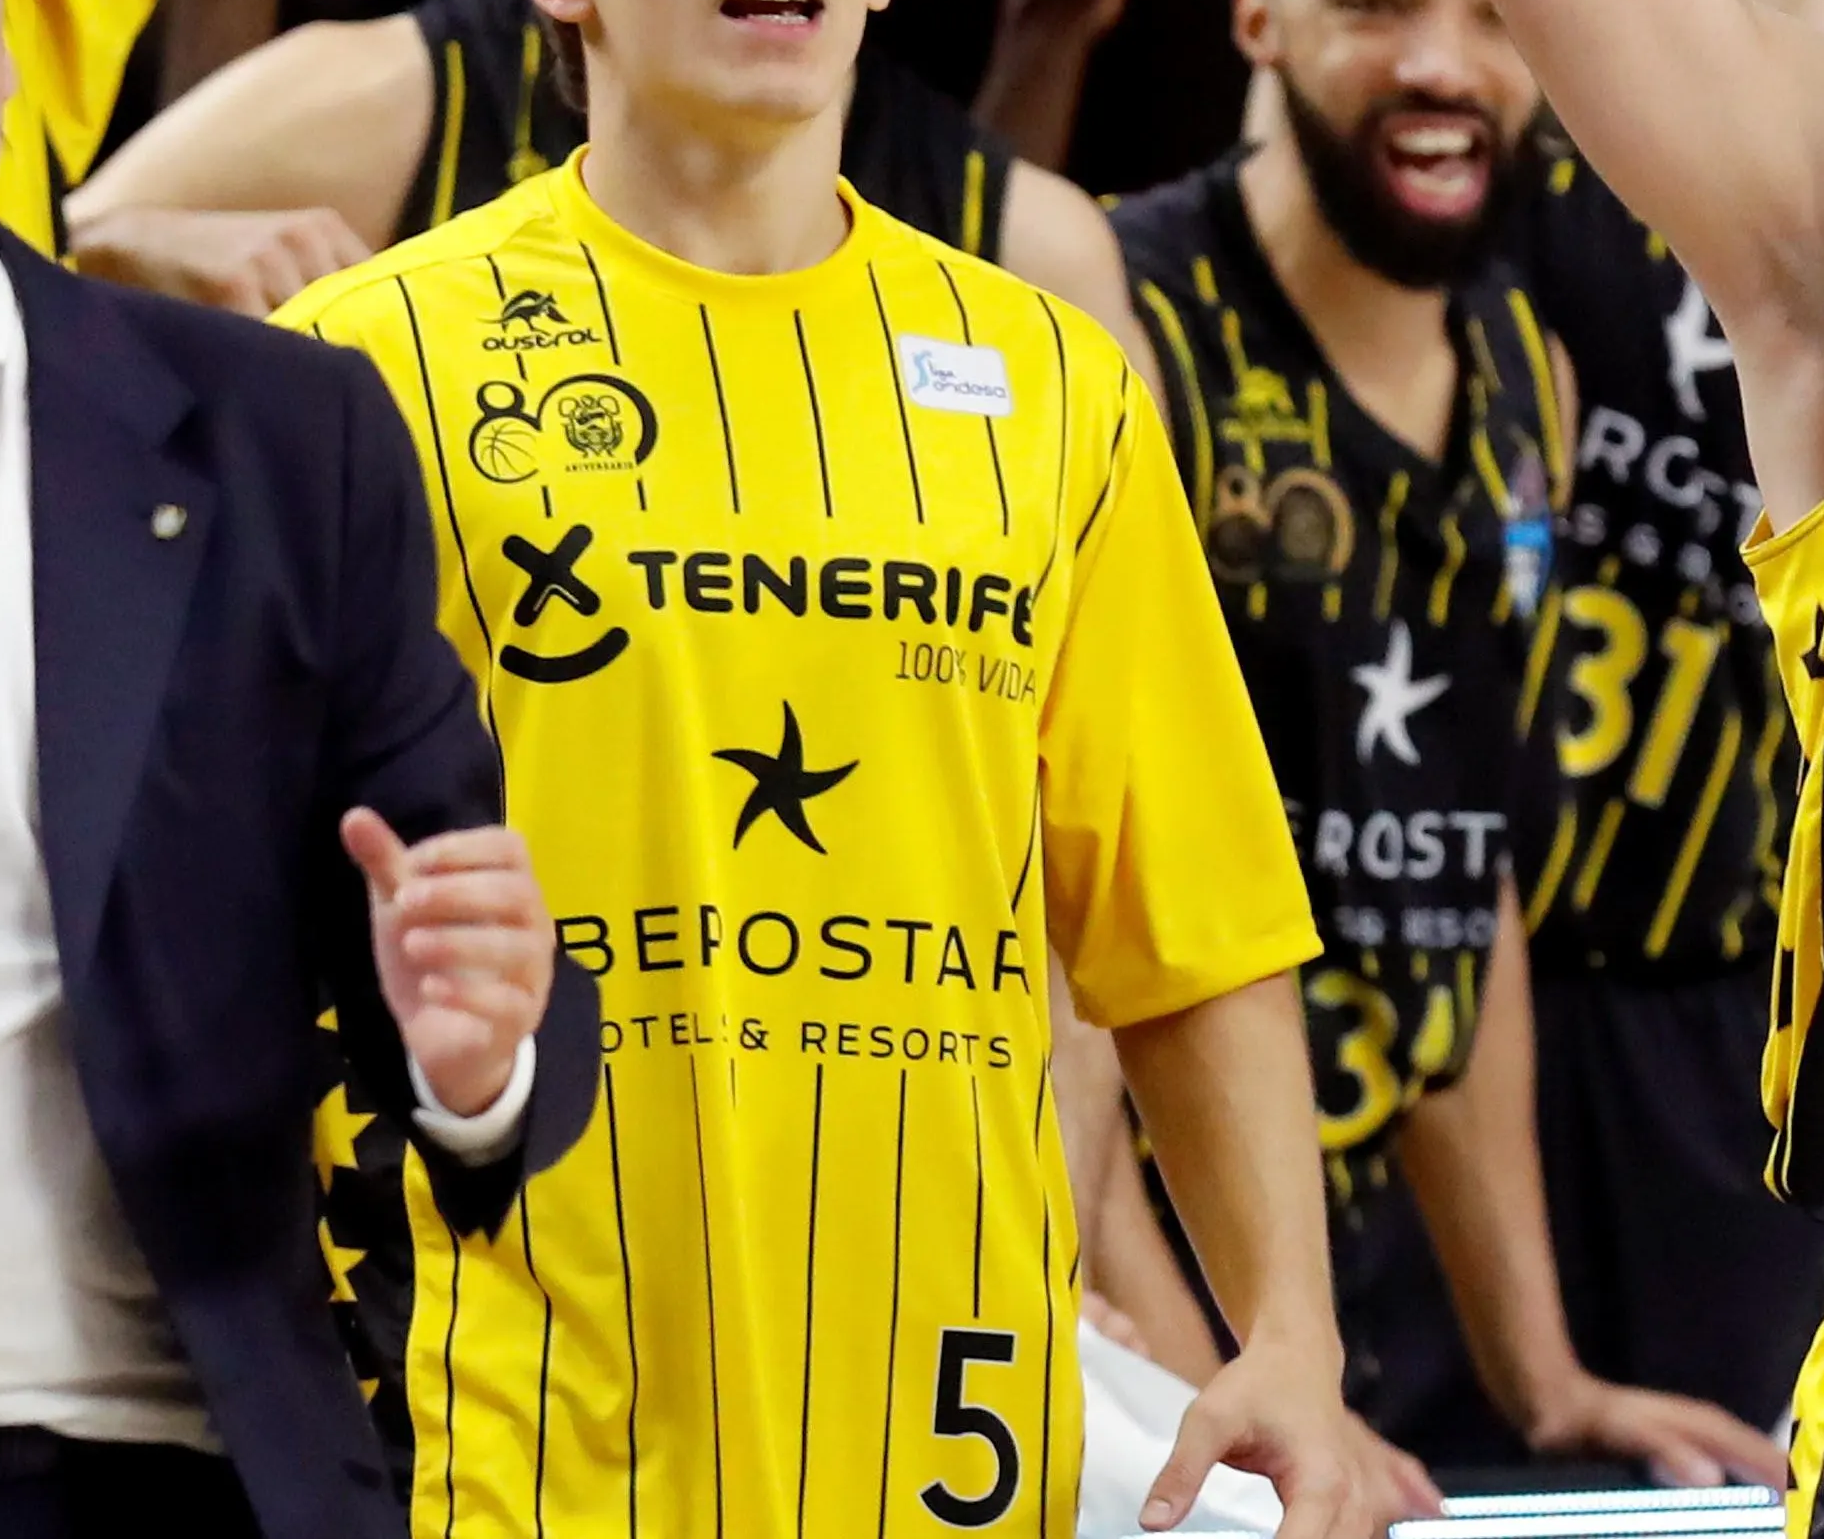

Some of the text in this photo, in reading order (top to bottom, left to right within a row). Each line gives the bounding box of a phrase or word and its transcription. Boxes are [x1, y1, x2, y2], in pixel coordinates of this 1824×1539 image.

[482, 328, 604, 351] austral
[628, 550, 1034, 648] TENERIFE
[896, 641, 1037, 706] 100% VIDA
[1556, 585, 1720, 808] 31
[555, 903, 1031, 993] BEROSTAR
[740, 1017, 770, 1051] &
[800, 1021, 1013, 1069] RESORTS
[919, 1328, 1022, 1529] 5
